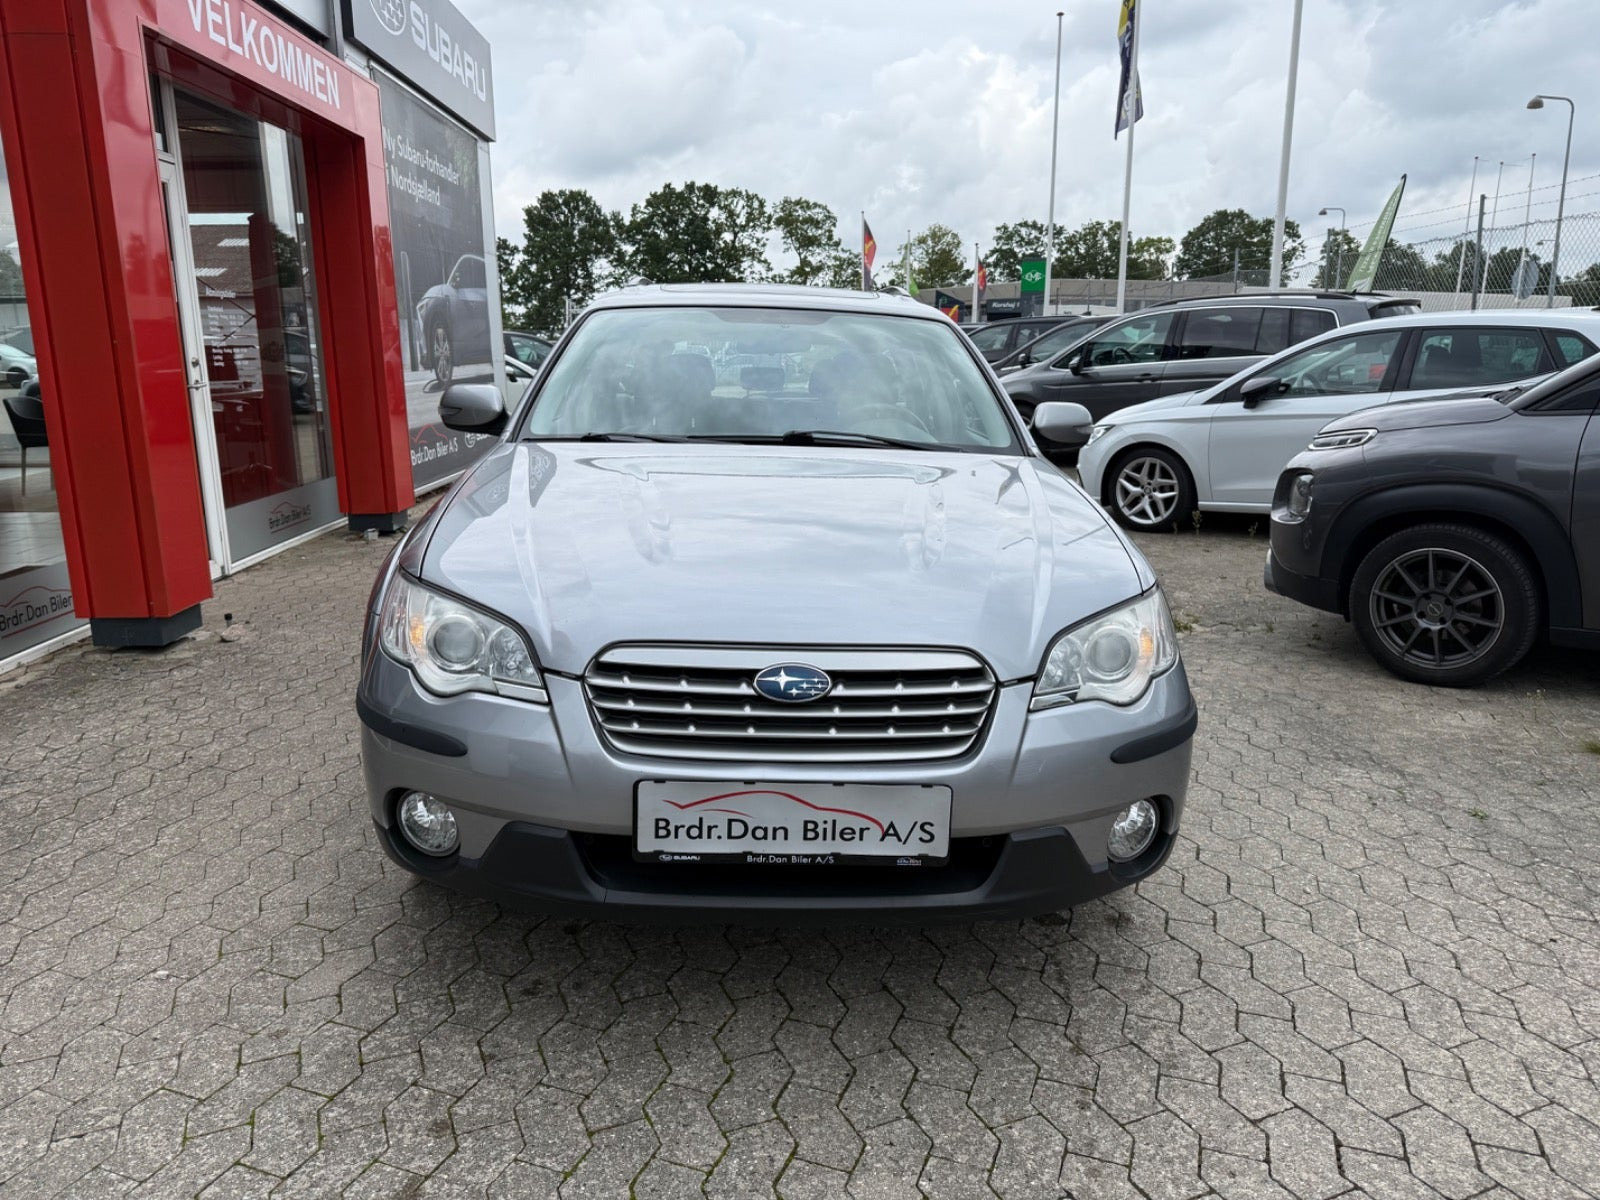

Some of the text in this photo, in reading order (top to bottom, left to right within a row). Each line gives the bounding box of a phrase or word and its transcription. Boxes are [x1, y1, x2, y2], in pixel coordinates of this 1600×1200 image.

[186, 0, 340, 109] VELKOMMEN
[410, 0, 487, 102] SUBARU
[397, 135, 459, 186] Subaru-forhandler
[391, 165, 441, 206] Nordsjælland
[410, 446, 437, 466] Brdr.Dan
[436, 441, 449, 458] Biler
[0, 594, 73, 632] Brdr.Dan Biler
[654, 817, 936, 845] Brdr.Dan Biler A/S
[747, 855, 835, 865] Brdr.Dan Biler A/S
